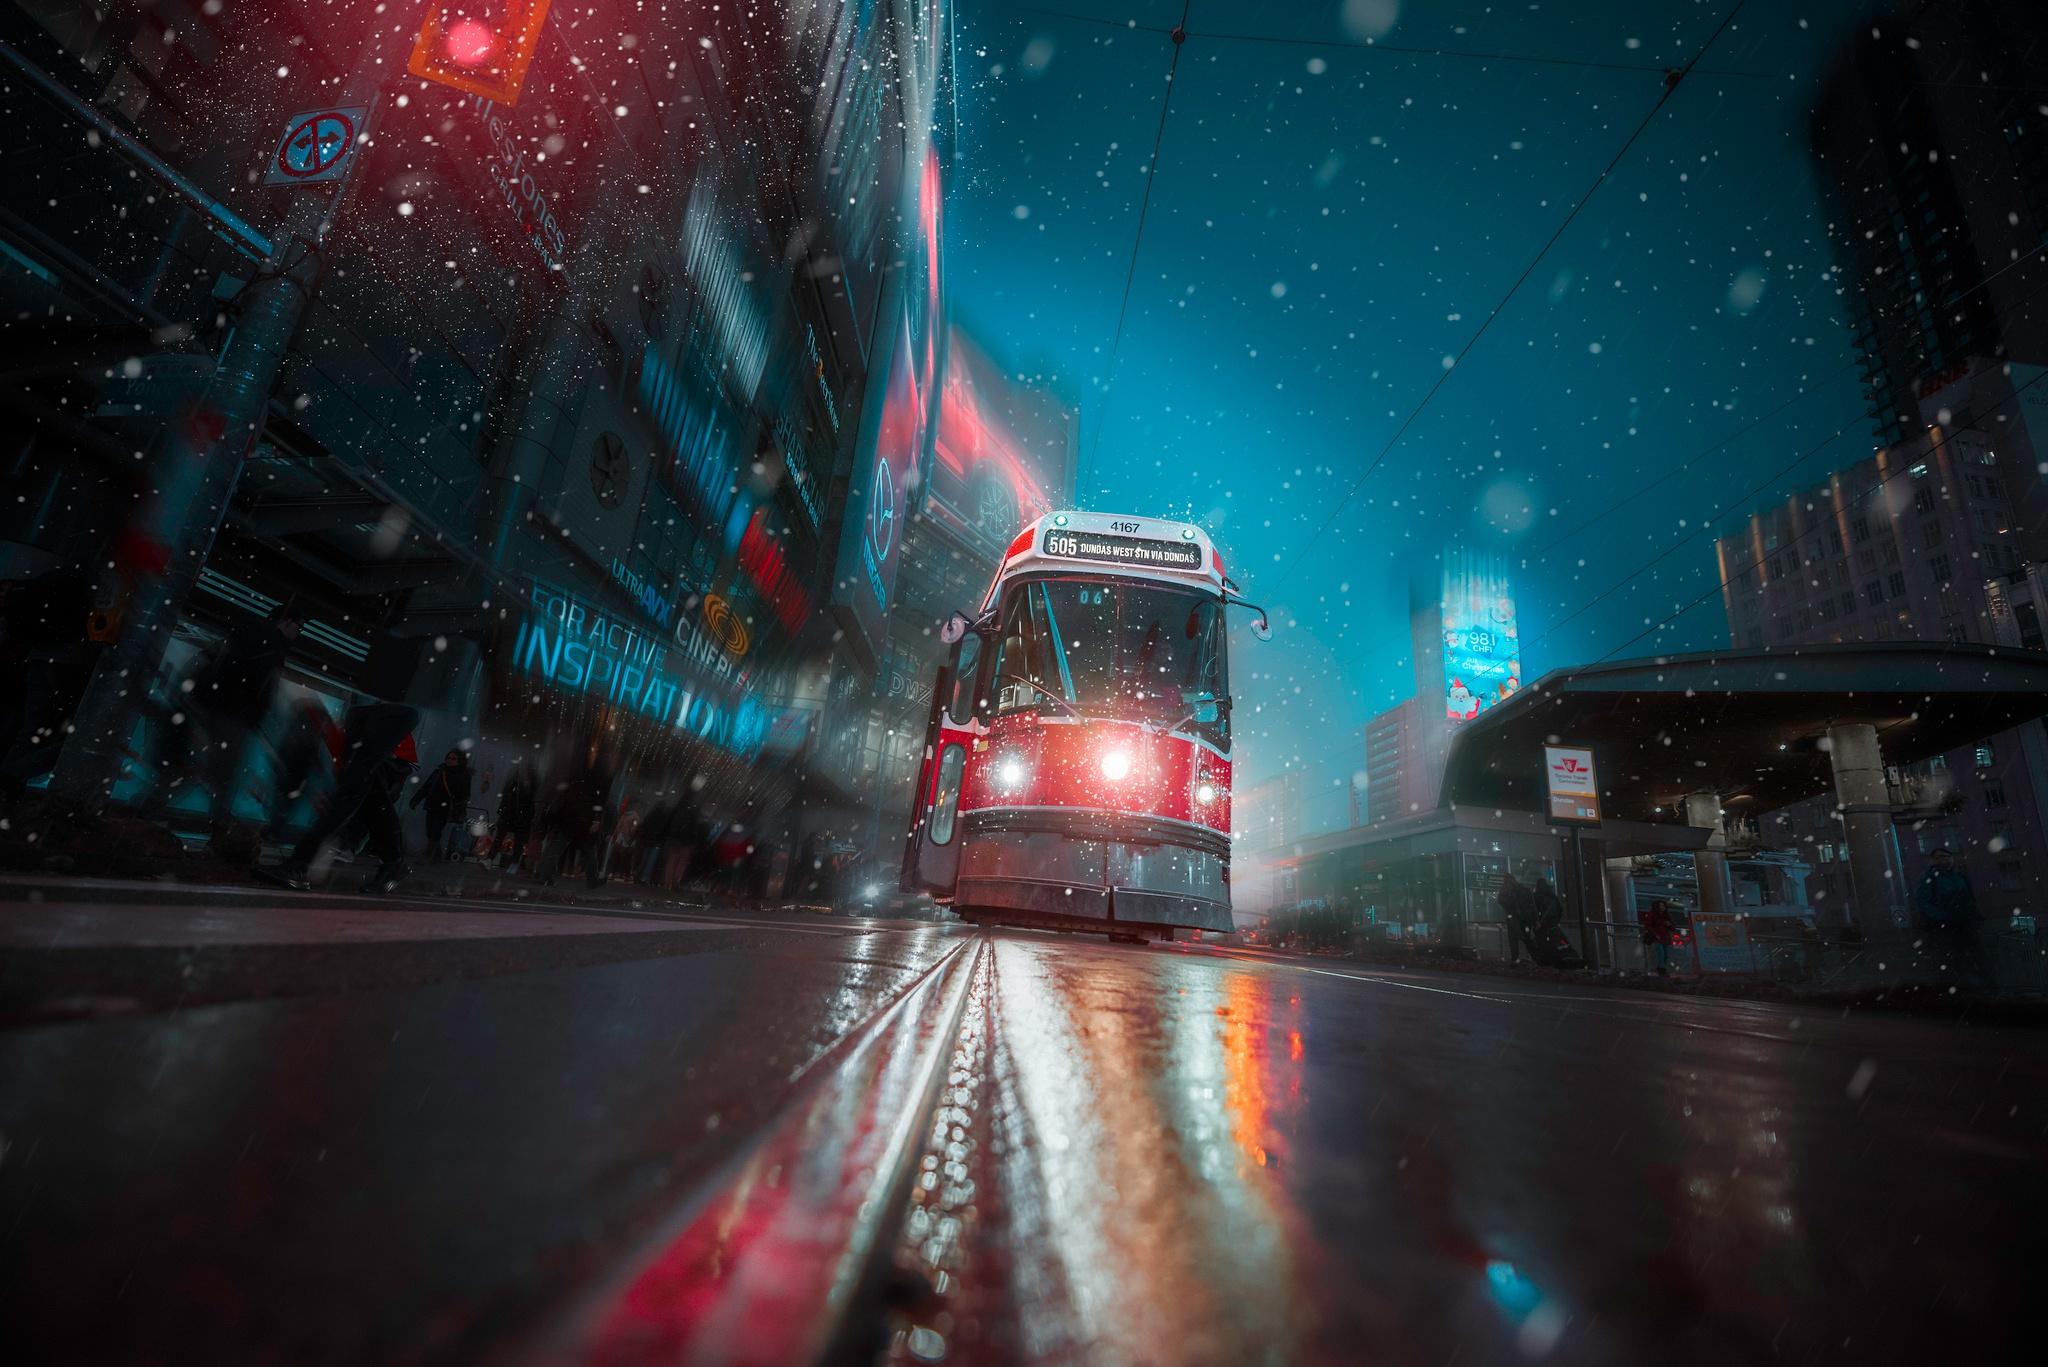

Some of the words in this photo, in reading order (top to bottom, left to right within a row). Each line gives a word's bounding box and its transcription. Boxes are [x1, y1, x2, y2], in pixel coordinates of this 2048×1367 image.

[1110, 521, 1140, 534] 4167
[1049, 537, 1077, 556] 505
[1080, 543, 1112, 556] DUNDAS
[1112, 545, 1134, 558] WEST
[1135, 547, 1150, 559] STN
[1151, 549, 1164, 561] VIA
[1164, 551, 1195, 564] DUNDAS
[531, 586, 586, 637] FOR
[589, 616, 667, 672] ACTIVE
[1470, 632, 1496, 647] 98.1
[512, 620, 731, 745] INSPIRATION
